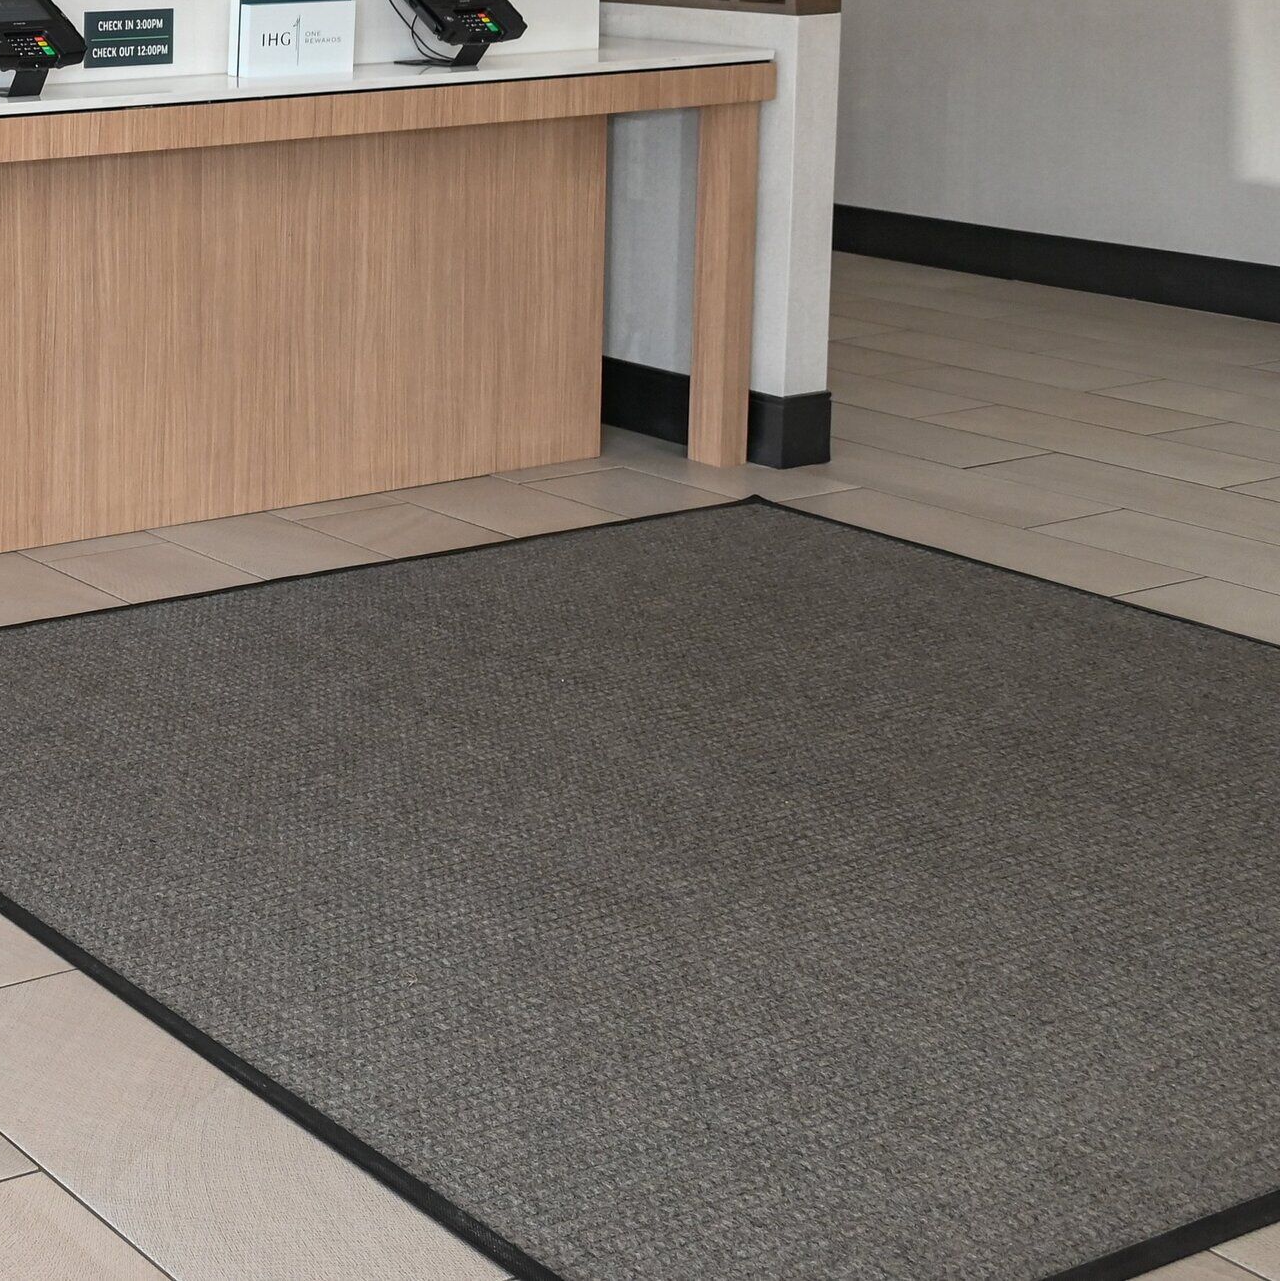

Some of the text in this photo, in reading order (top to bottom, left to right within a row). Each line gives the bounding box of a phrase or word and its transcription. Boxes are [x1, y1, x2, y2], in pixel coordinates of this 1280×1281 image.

[98, 18, 164, 32] CHECK IN 3:00PM
[261, 31, 291, 47] IHG
[304, 36, 342, 44] REWARDS
[92, 44, 168, 59] CHECK OUT 12:00PM
